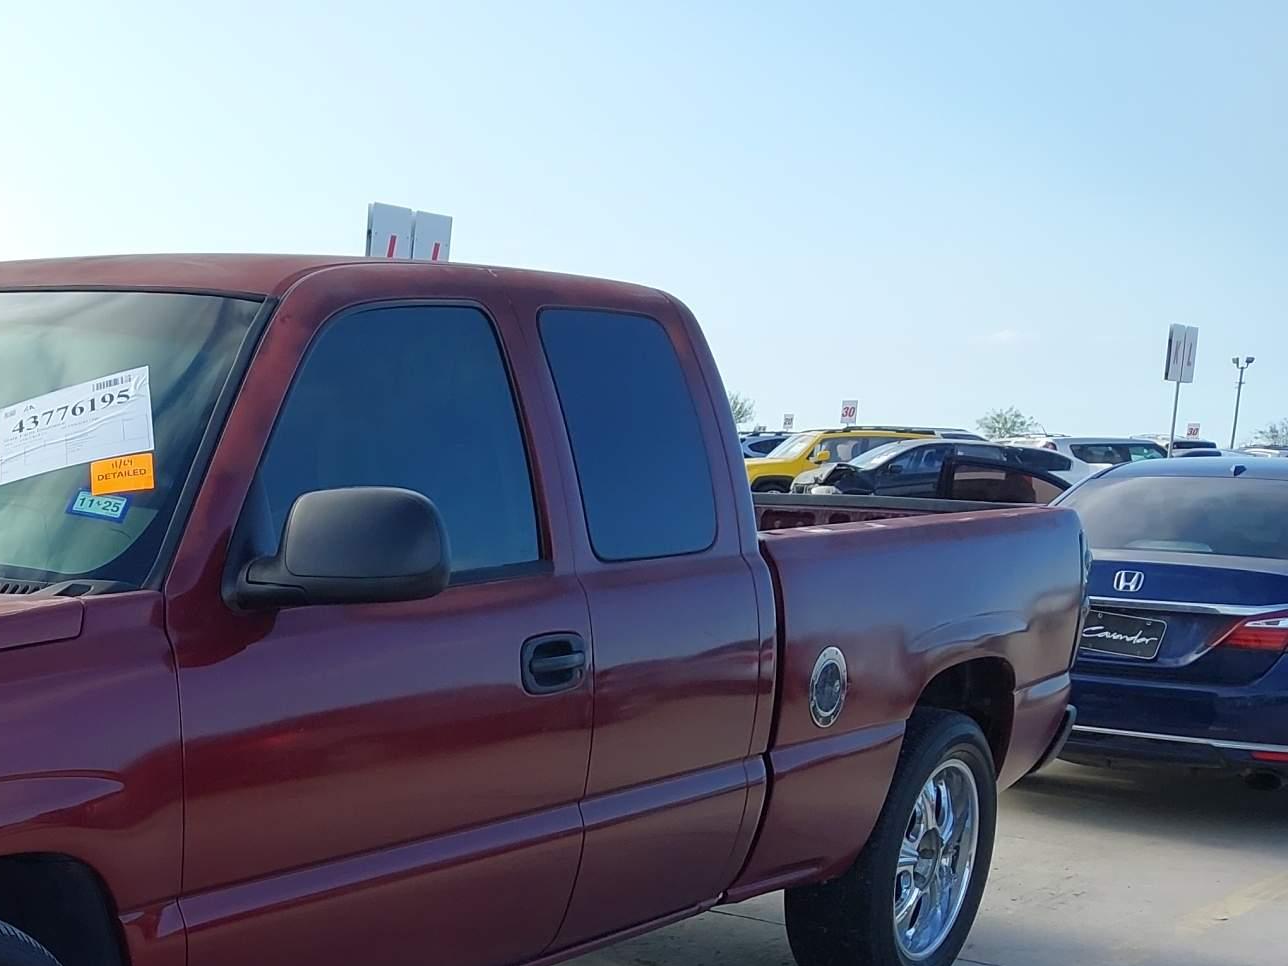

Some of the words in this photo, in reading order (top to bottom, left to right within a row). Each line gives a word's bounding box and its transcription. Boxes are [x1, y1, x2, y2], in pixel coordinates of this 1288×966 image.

[12, 388, 131, 433] 43776195
[841, 406, 856, 418] 30
[97, 469, 146, 481] DETAILED
[102, 501, 122, 513] 25
